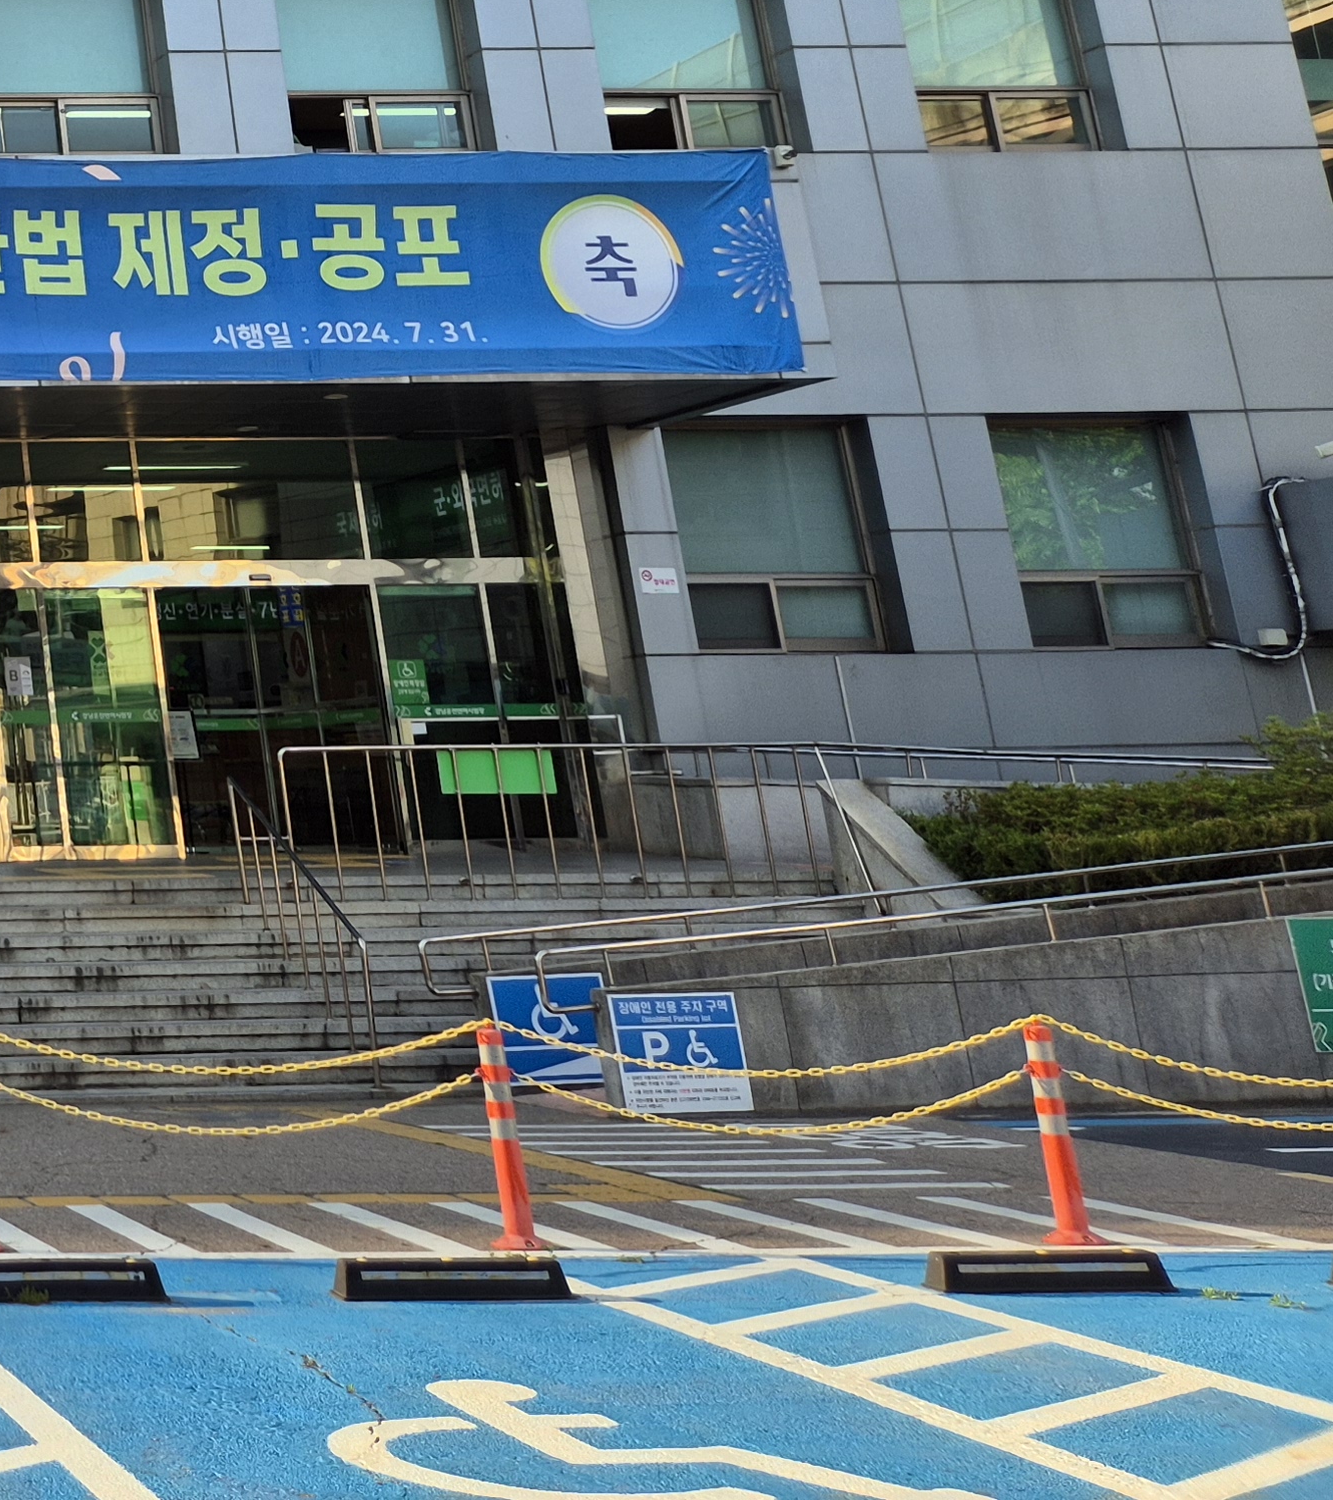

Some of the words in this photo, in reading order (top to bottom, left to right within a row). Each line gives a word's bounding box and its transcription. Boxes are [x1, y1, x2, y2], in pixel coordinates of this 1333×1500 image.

[108, 203, 471, 297] 제정·공포
[584, 234, 639, 298] 축
[212, 320, 293, 351] 시행일
[318, 320, 401, 346] 2024.
[442, 319, 489, 345] 31.
[618, 1001, 652, 1015] 장애인
[654, 1000, 677, 1014] 전용
[680, 1000, 703, 1013] 주차
[706, 999, 729, 1012] 구역
[642, 1031, 670, 1063] P
